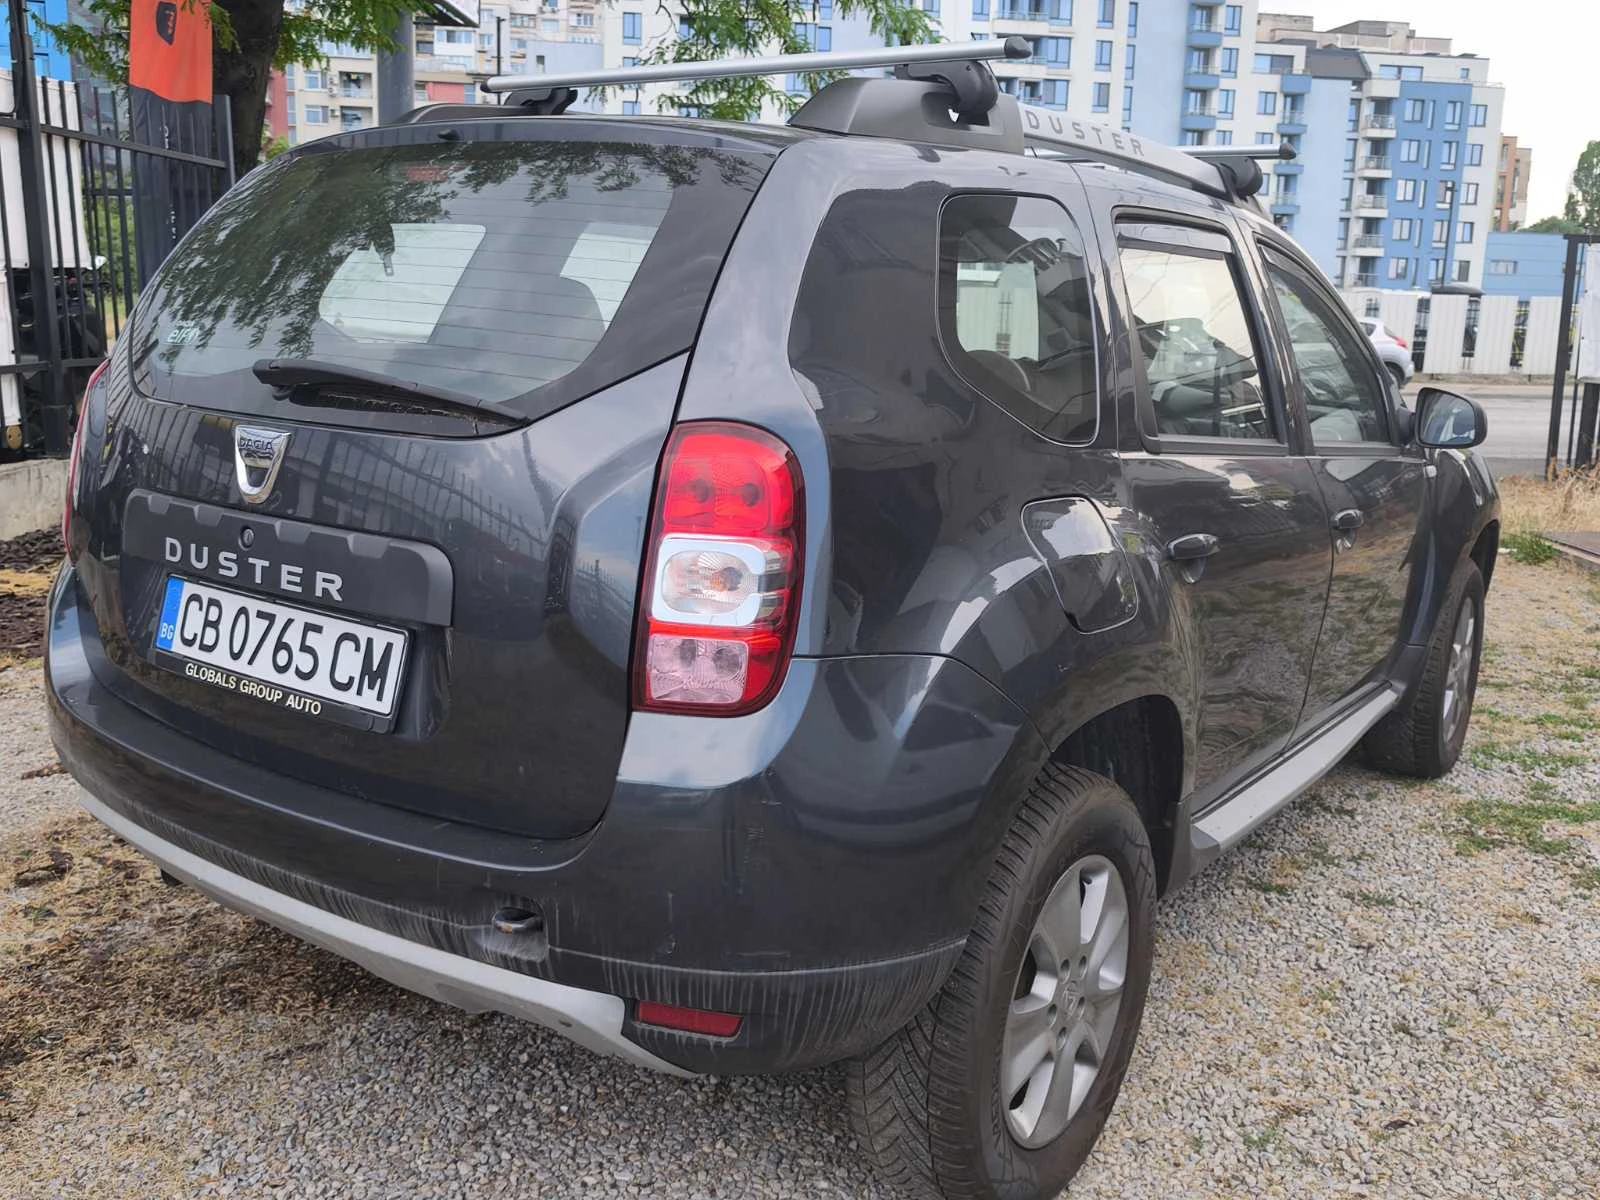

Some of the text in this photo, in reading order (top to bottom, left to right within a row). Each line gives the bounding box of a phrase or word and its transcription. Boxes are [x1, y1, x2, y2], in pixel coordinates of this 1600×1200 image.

[1024, 110, 1145, 157] DUSTER
[239, 438, 274, 451] DACIA
[165, 537, 343, 602] DUSTER
[160, 623, 175, 641] BG
[185, 662, 322, 715] GLOBALS GROUP AUTO
